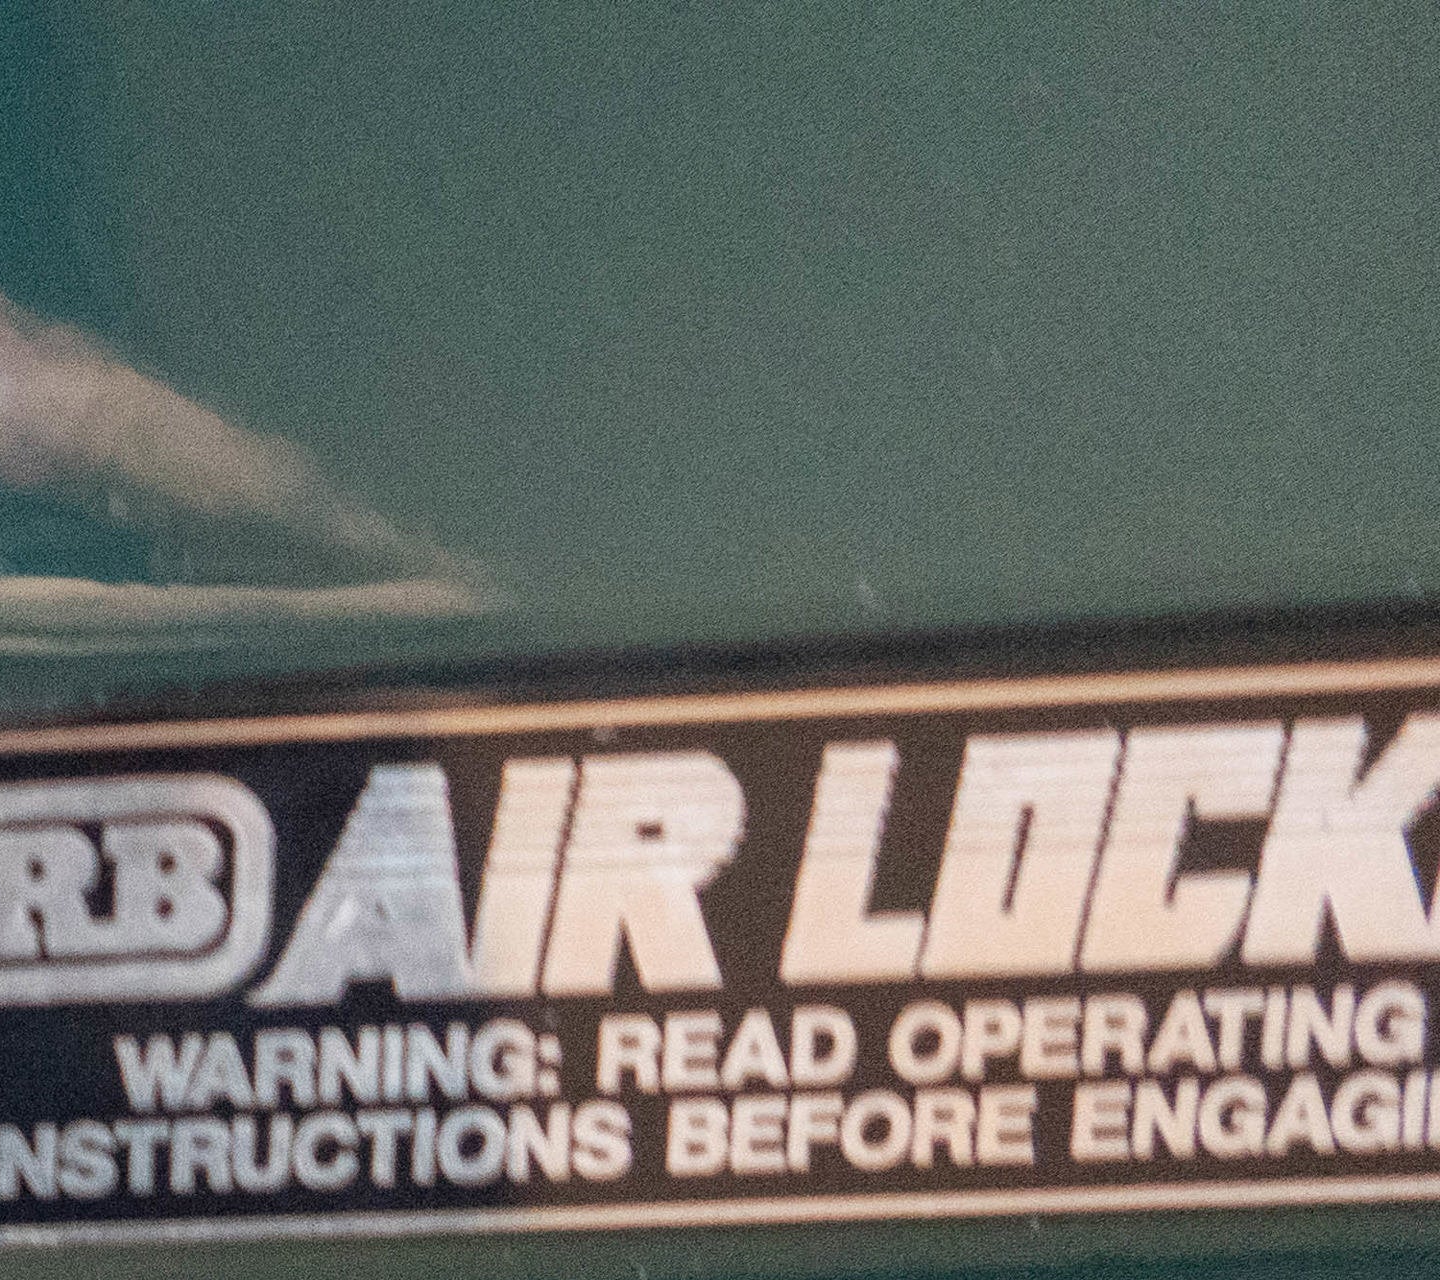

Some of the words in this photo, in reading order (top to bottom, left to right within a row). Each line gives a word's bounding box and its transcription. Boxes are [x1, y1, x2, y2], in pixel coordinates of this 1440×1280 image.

[246, 748, 746, 1004] AIR
[780, 712, 1440, 986] LOCK
[114, 1018, 564, 1114] WARNING:
[596, 1004, 858, 1096] READ
[889, 980, 1428, 1087] OPERATING
[666, 1085, 1037, 1176] BEFORE
